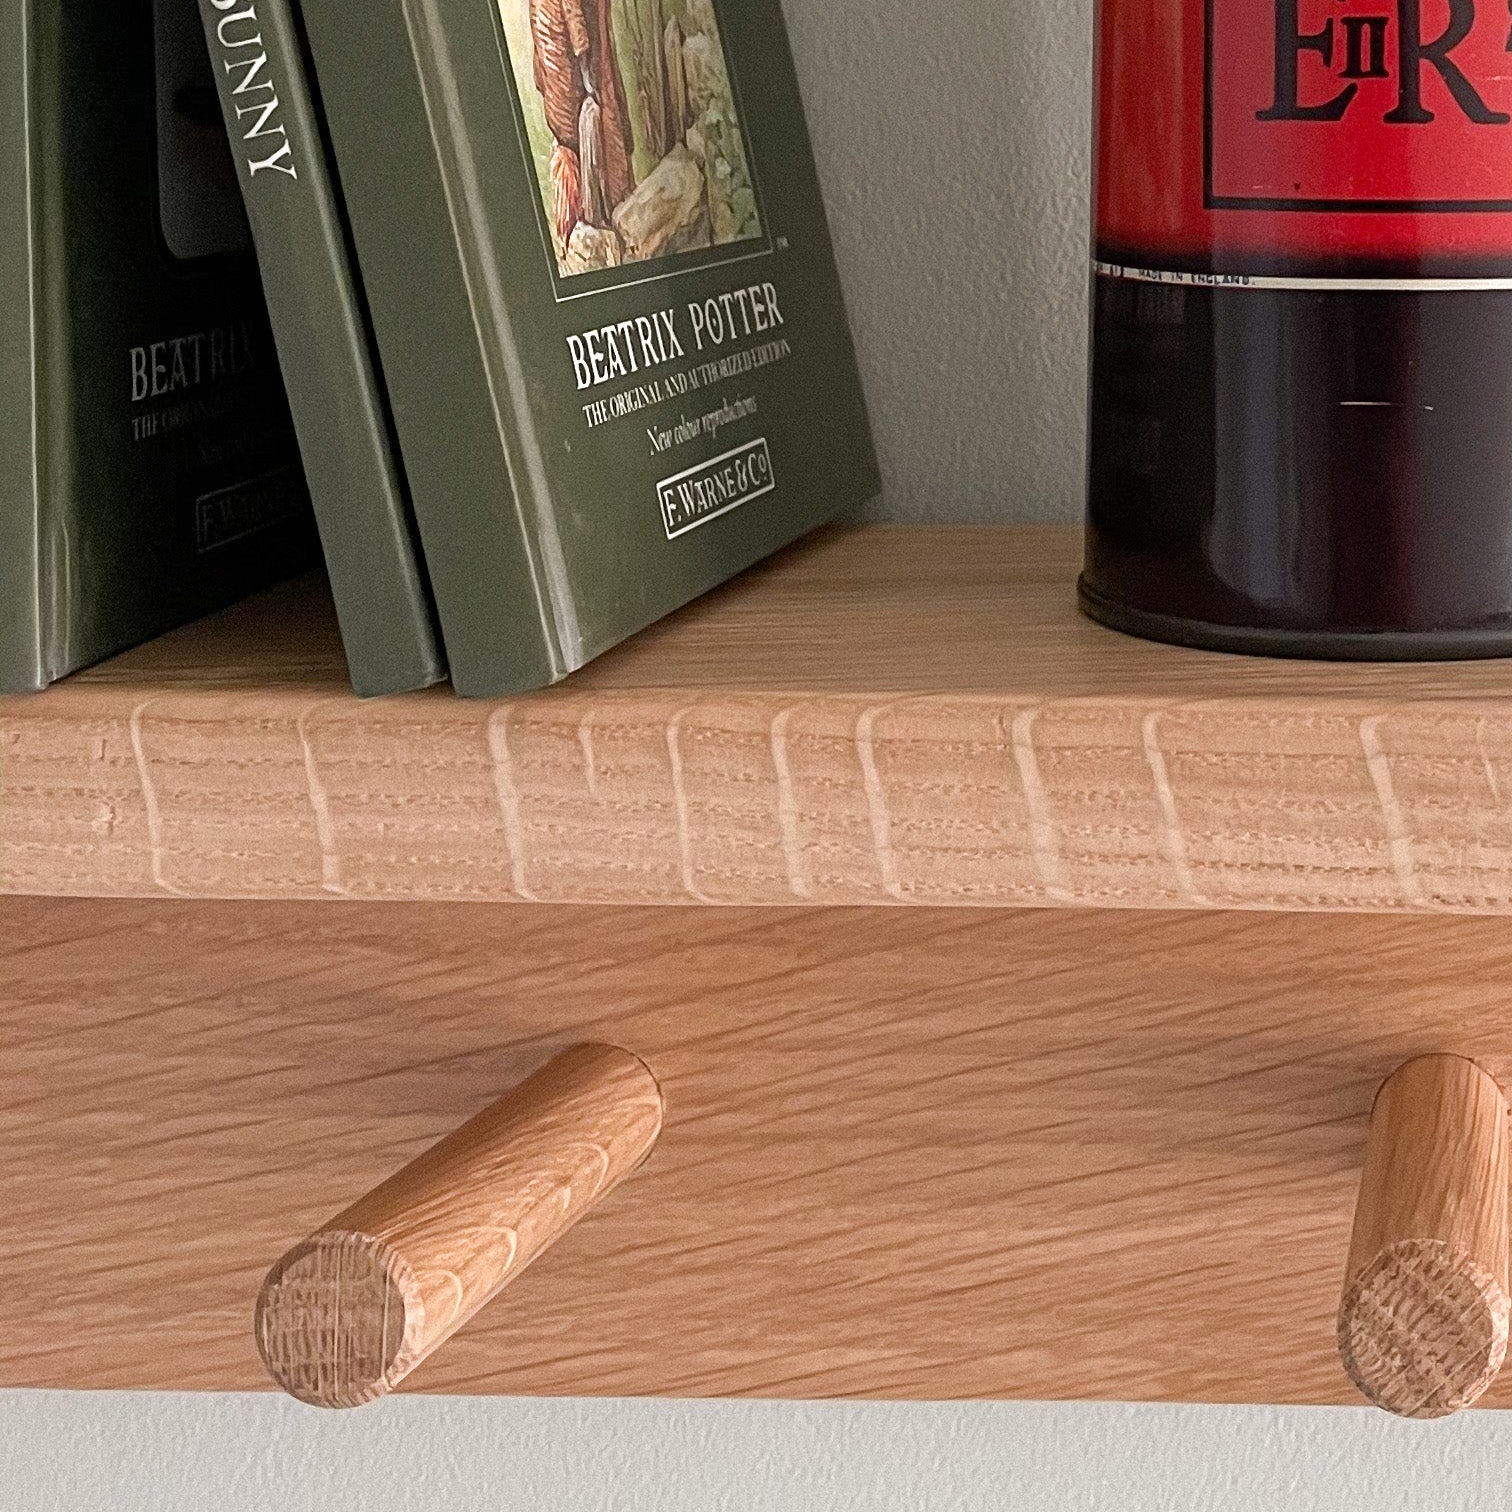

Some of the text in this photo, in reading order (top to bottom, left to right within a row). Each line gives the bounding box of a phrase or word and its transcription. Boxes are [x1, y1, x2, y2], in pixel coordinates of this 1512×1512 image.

[566, 282, 784, 390] BEATRIX POTTER
[582, 399, 609, 429] THE
[608, 381, 665, 419] ORIGINAL
[677, 466, 738, 518] WARNE
